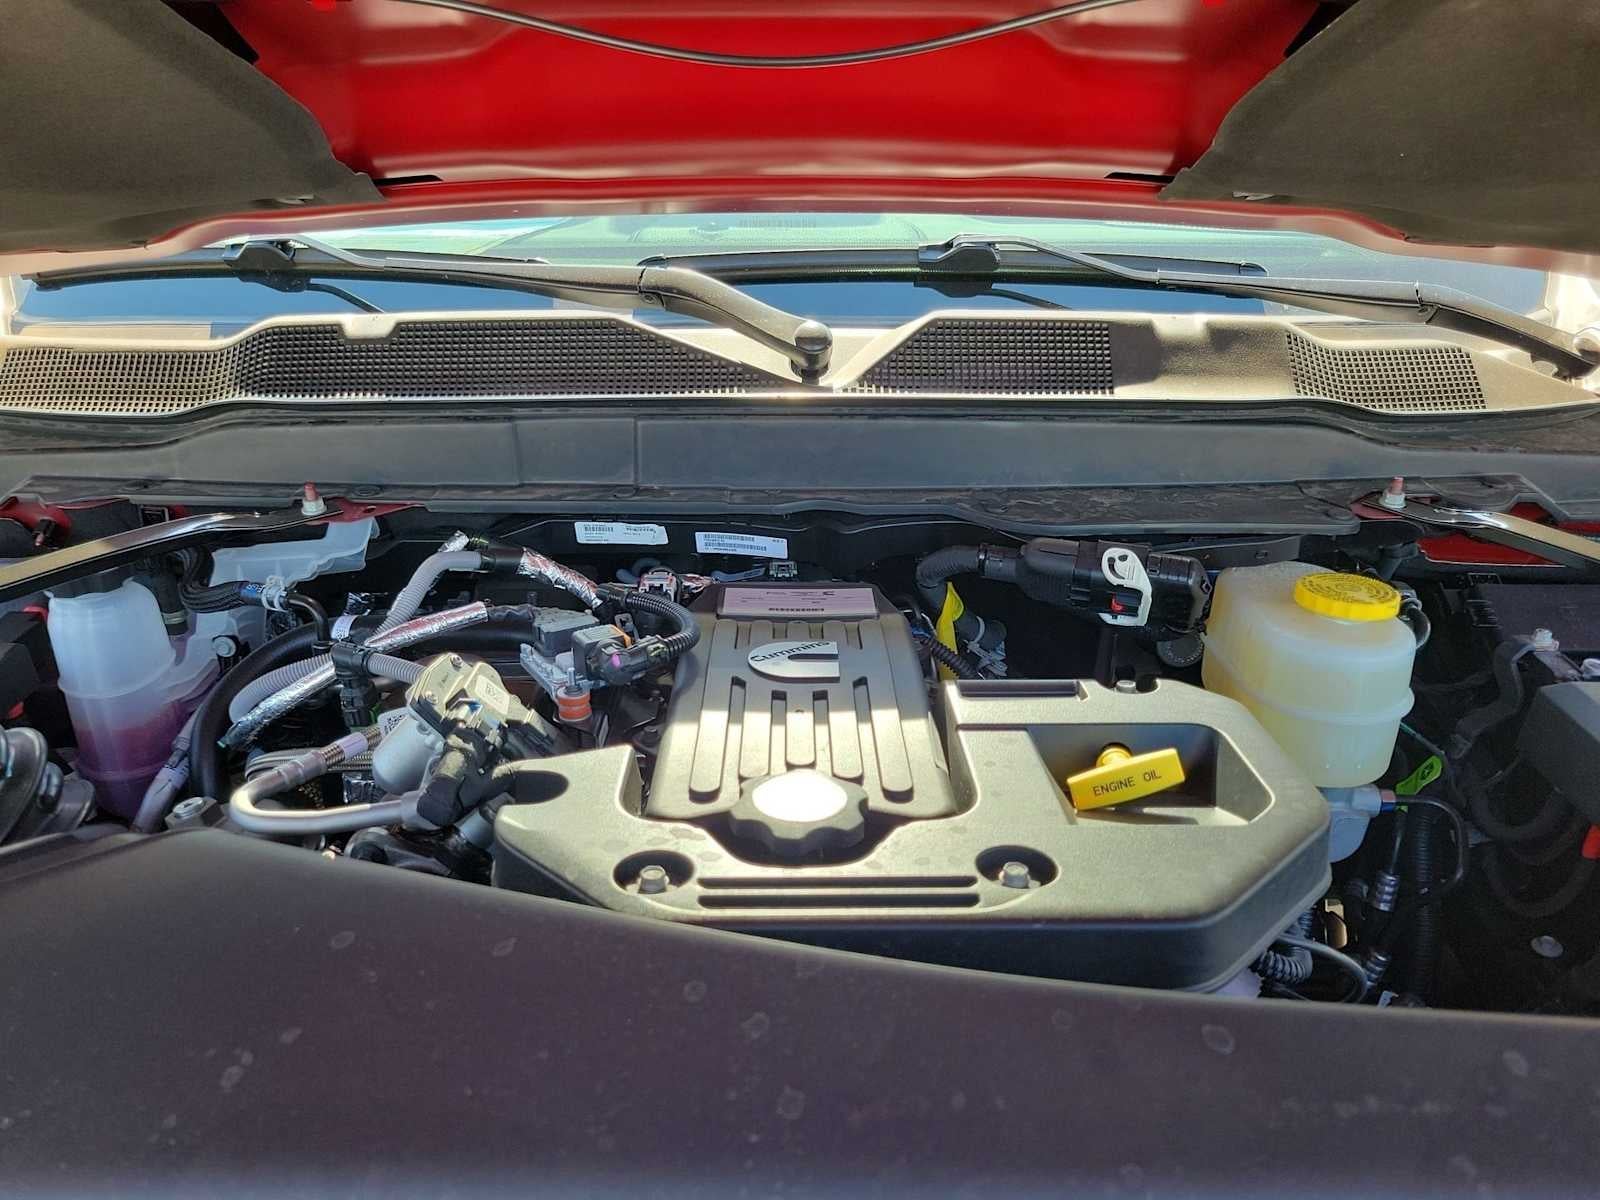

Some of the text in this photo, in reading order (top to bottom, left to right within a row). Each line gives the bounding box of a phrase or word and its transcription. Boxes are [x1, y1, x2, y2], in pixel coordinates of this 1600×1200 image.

[750, 642, 830, 662] Cummins
[1092, 769, 1162, 797] ENGINE OIL
